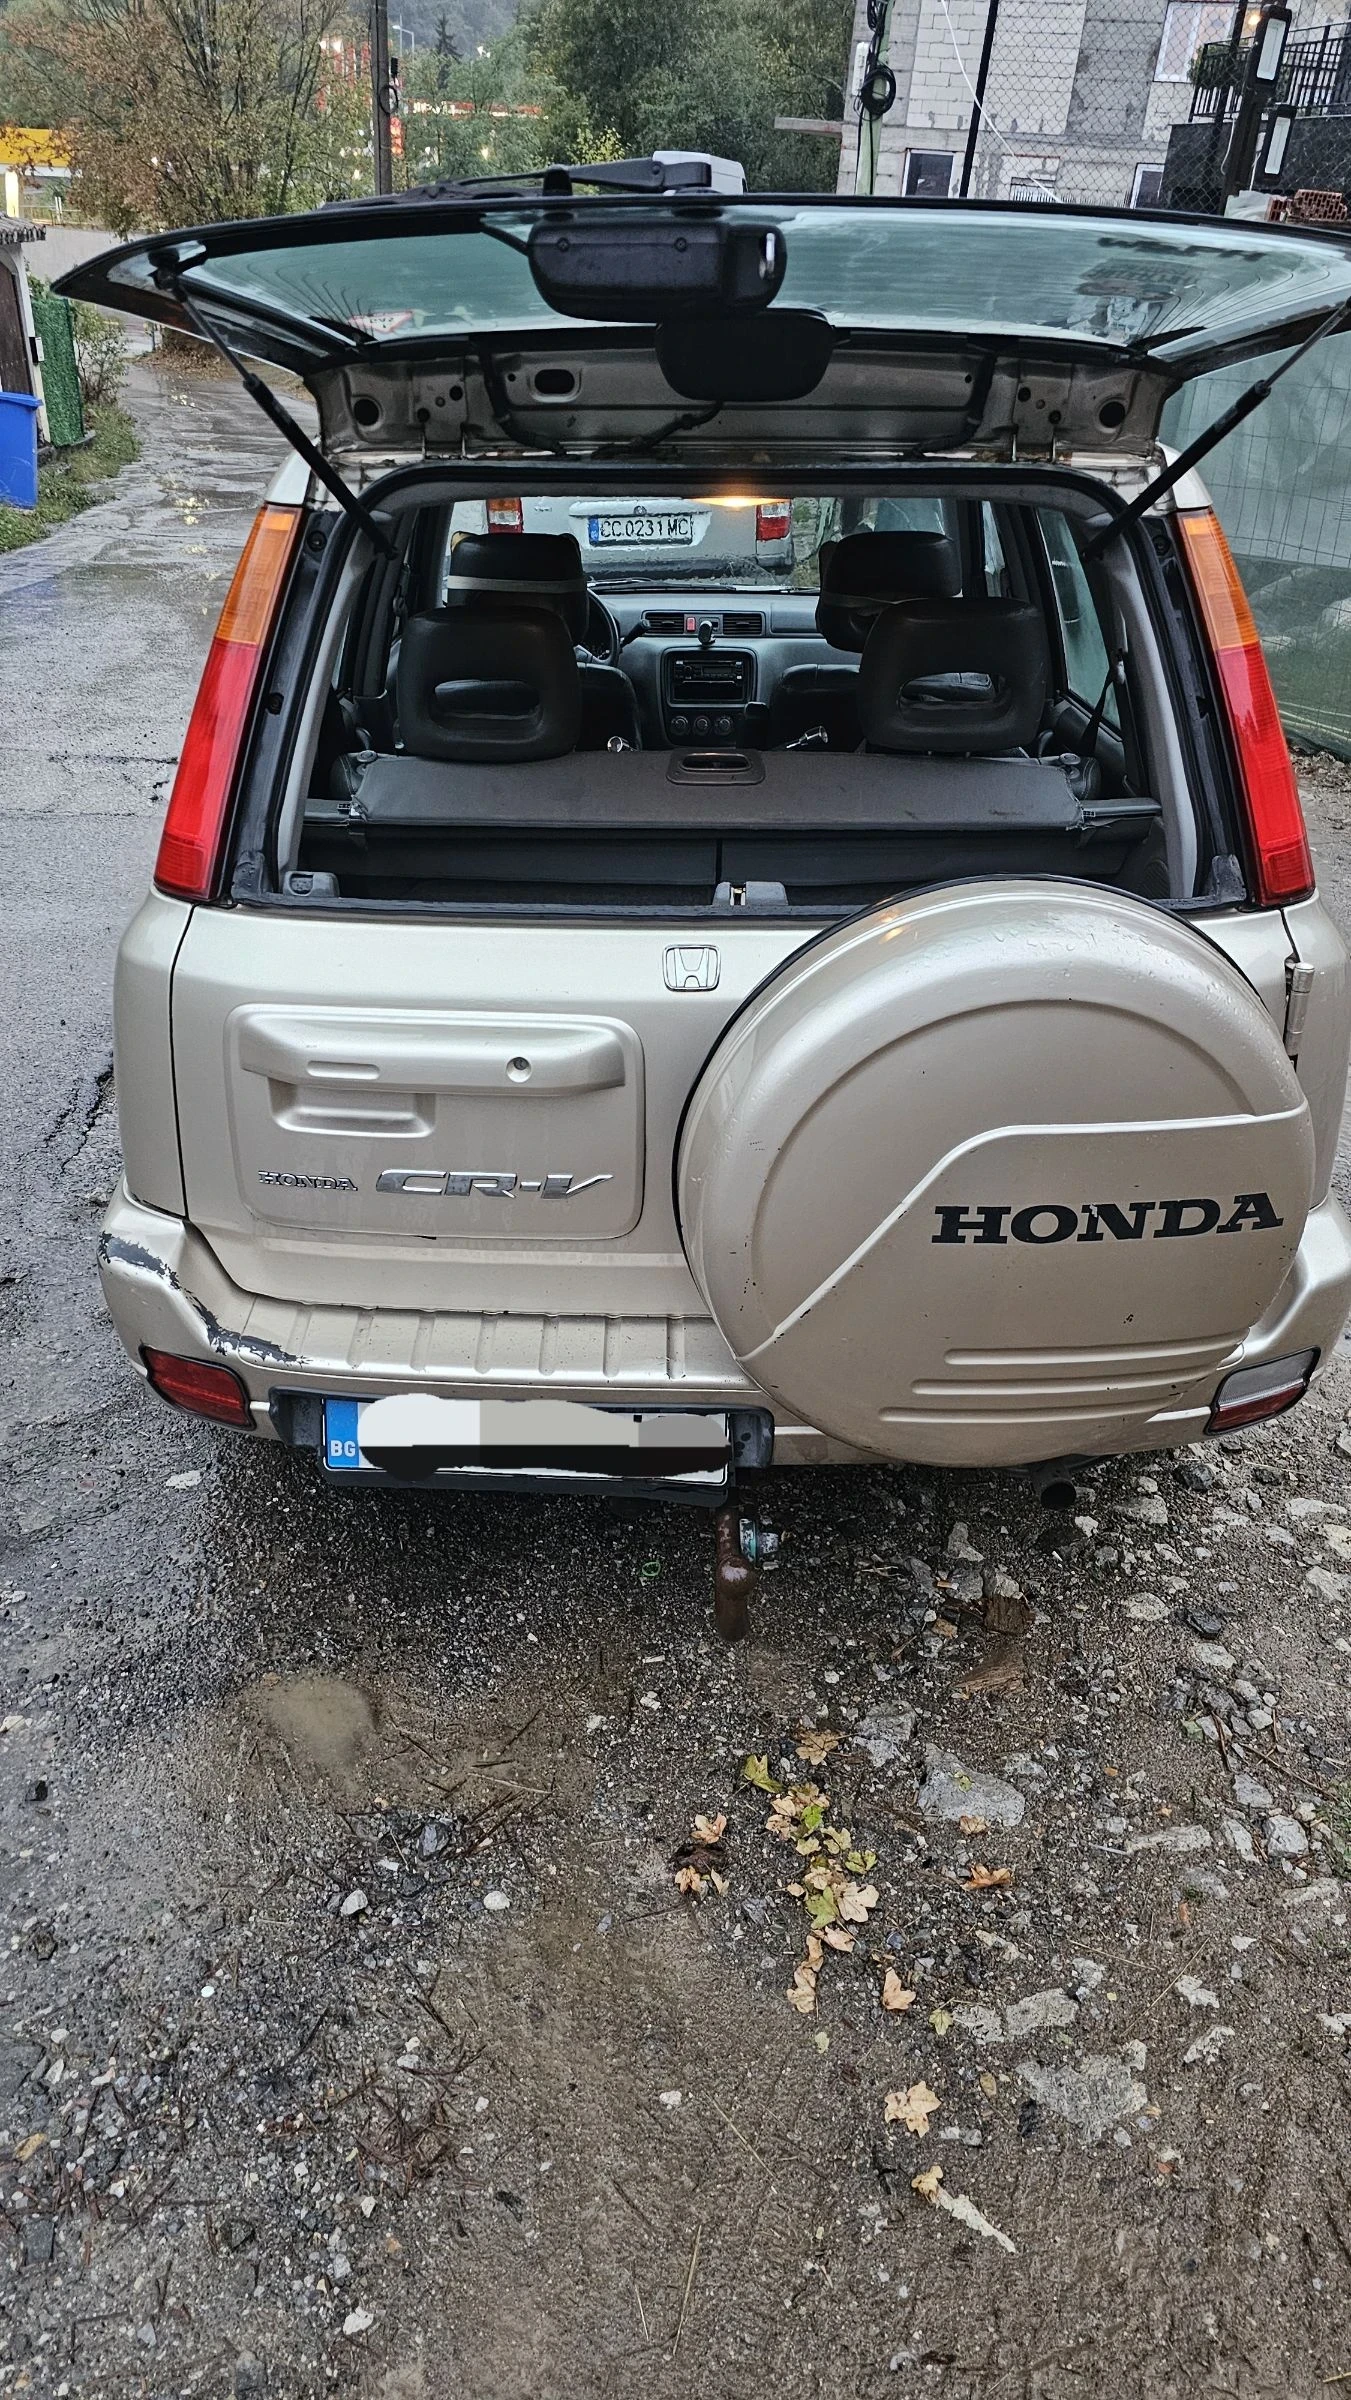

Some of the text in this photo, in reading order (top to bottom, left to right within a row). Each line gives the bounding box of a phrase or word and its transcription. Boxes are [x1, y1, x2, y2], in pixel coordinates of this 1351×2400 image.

[258, 1168, 614, 1199] HONDA CR-V
[931, 1192, 1284, 1244] HONDA
[330, 1439, 356, 1457] BG
